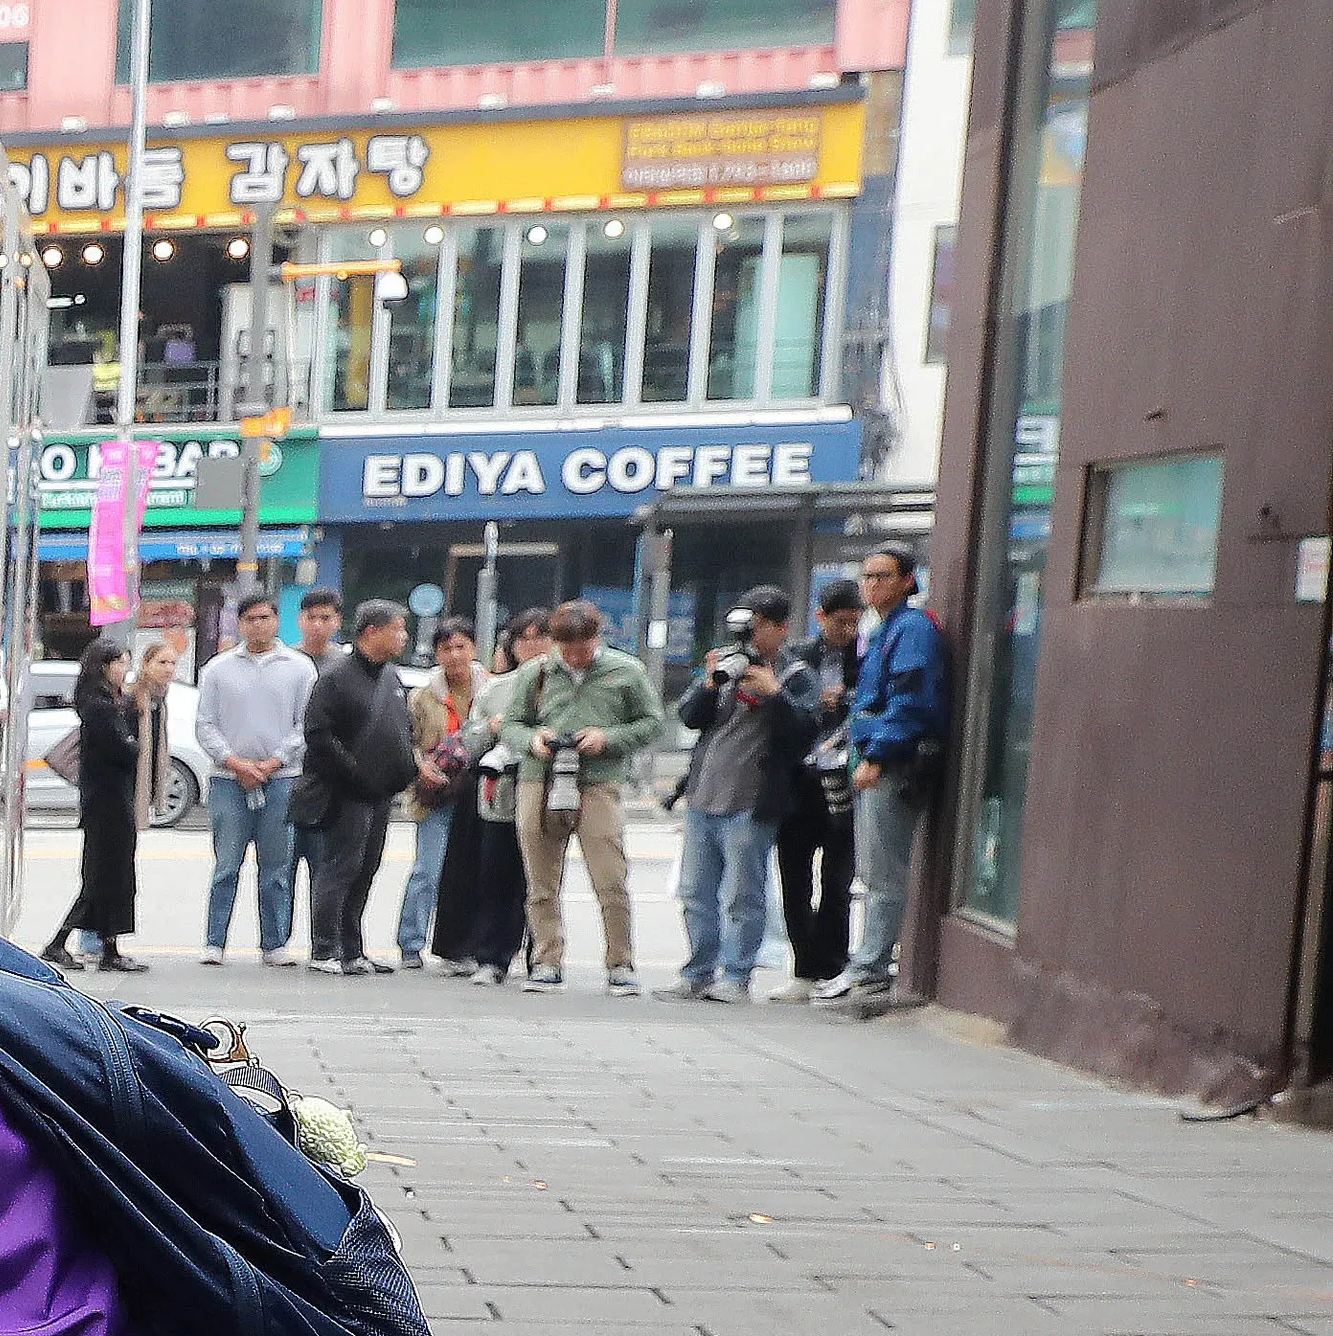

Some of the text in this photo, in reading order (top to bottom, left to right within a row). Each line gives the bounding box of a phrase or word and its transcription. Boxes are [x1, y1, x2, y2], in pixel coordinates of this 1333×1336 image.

[226, 135, 432, 205] 감자탕
[363, 442, 814, 498] EDIYA COFFEE
